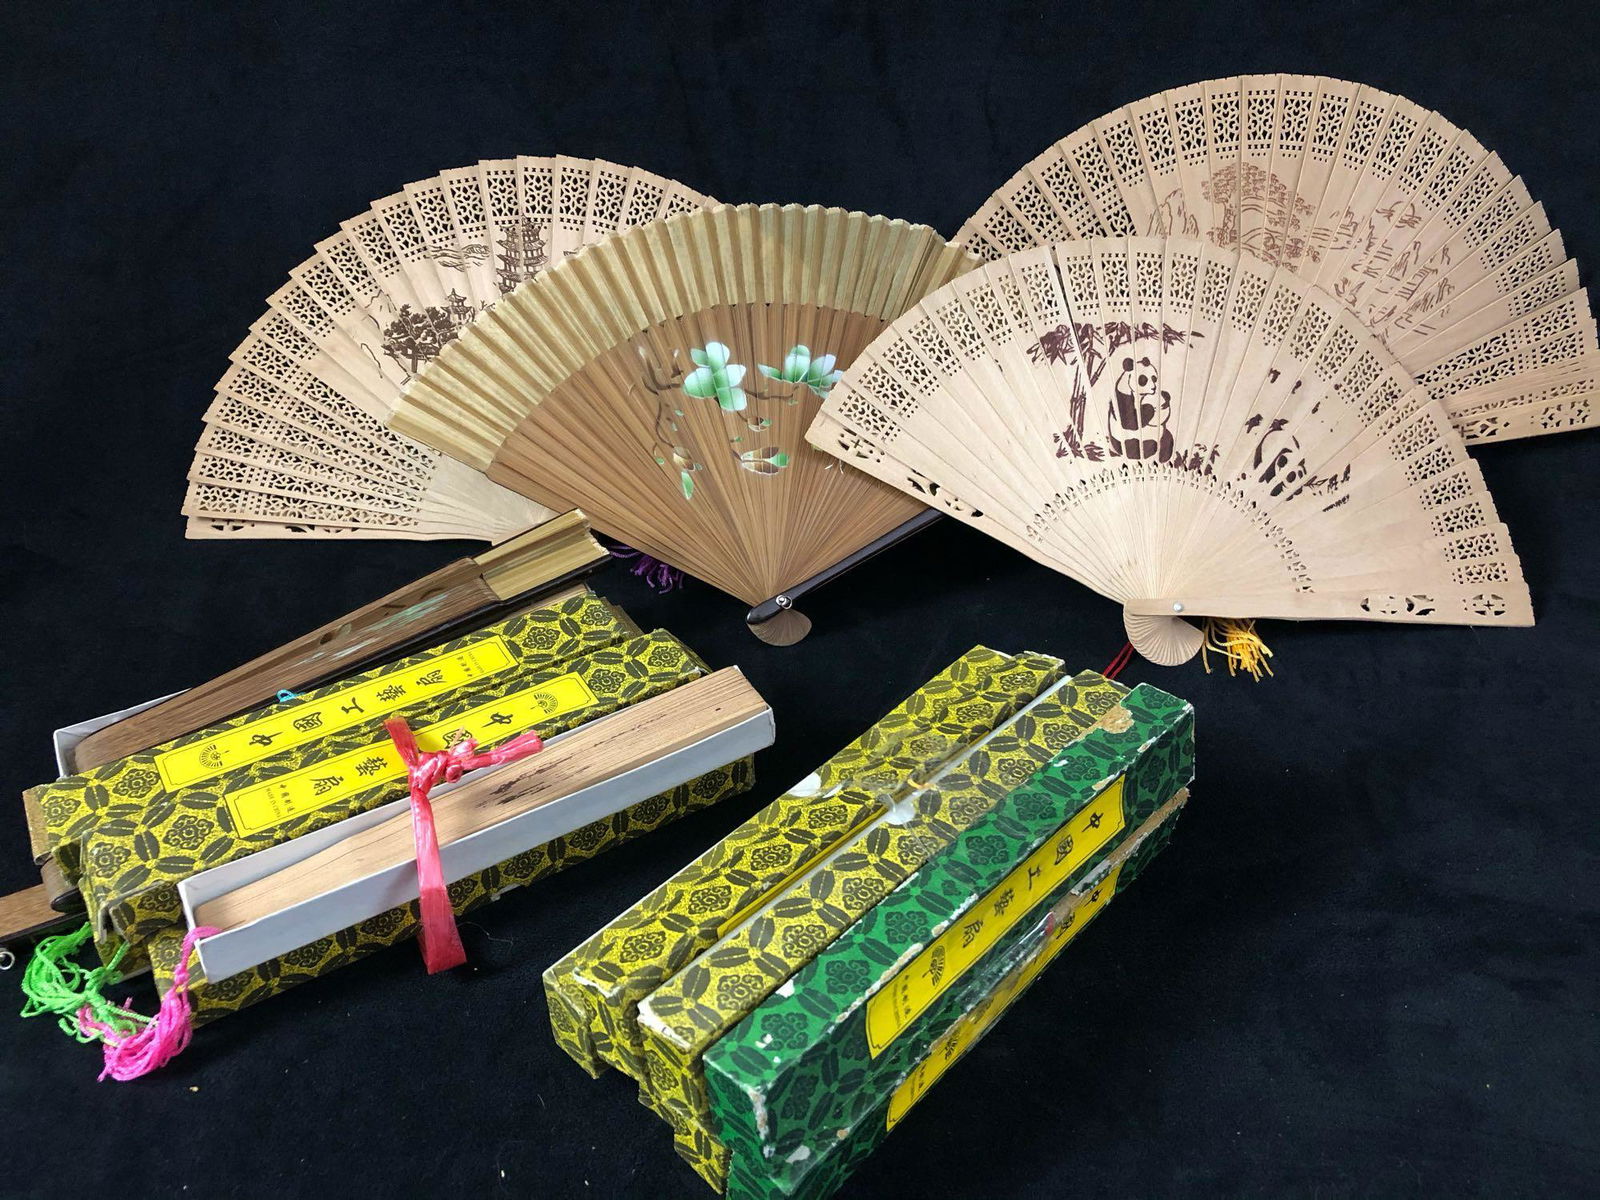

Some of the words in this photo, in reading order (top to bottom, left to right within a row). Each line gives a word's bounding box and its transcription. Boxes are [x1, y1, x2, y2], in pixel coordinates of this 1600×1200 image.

[249, 669, 446, 746] 中國工藝扇
